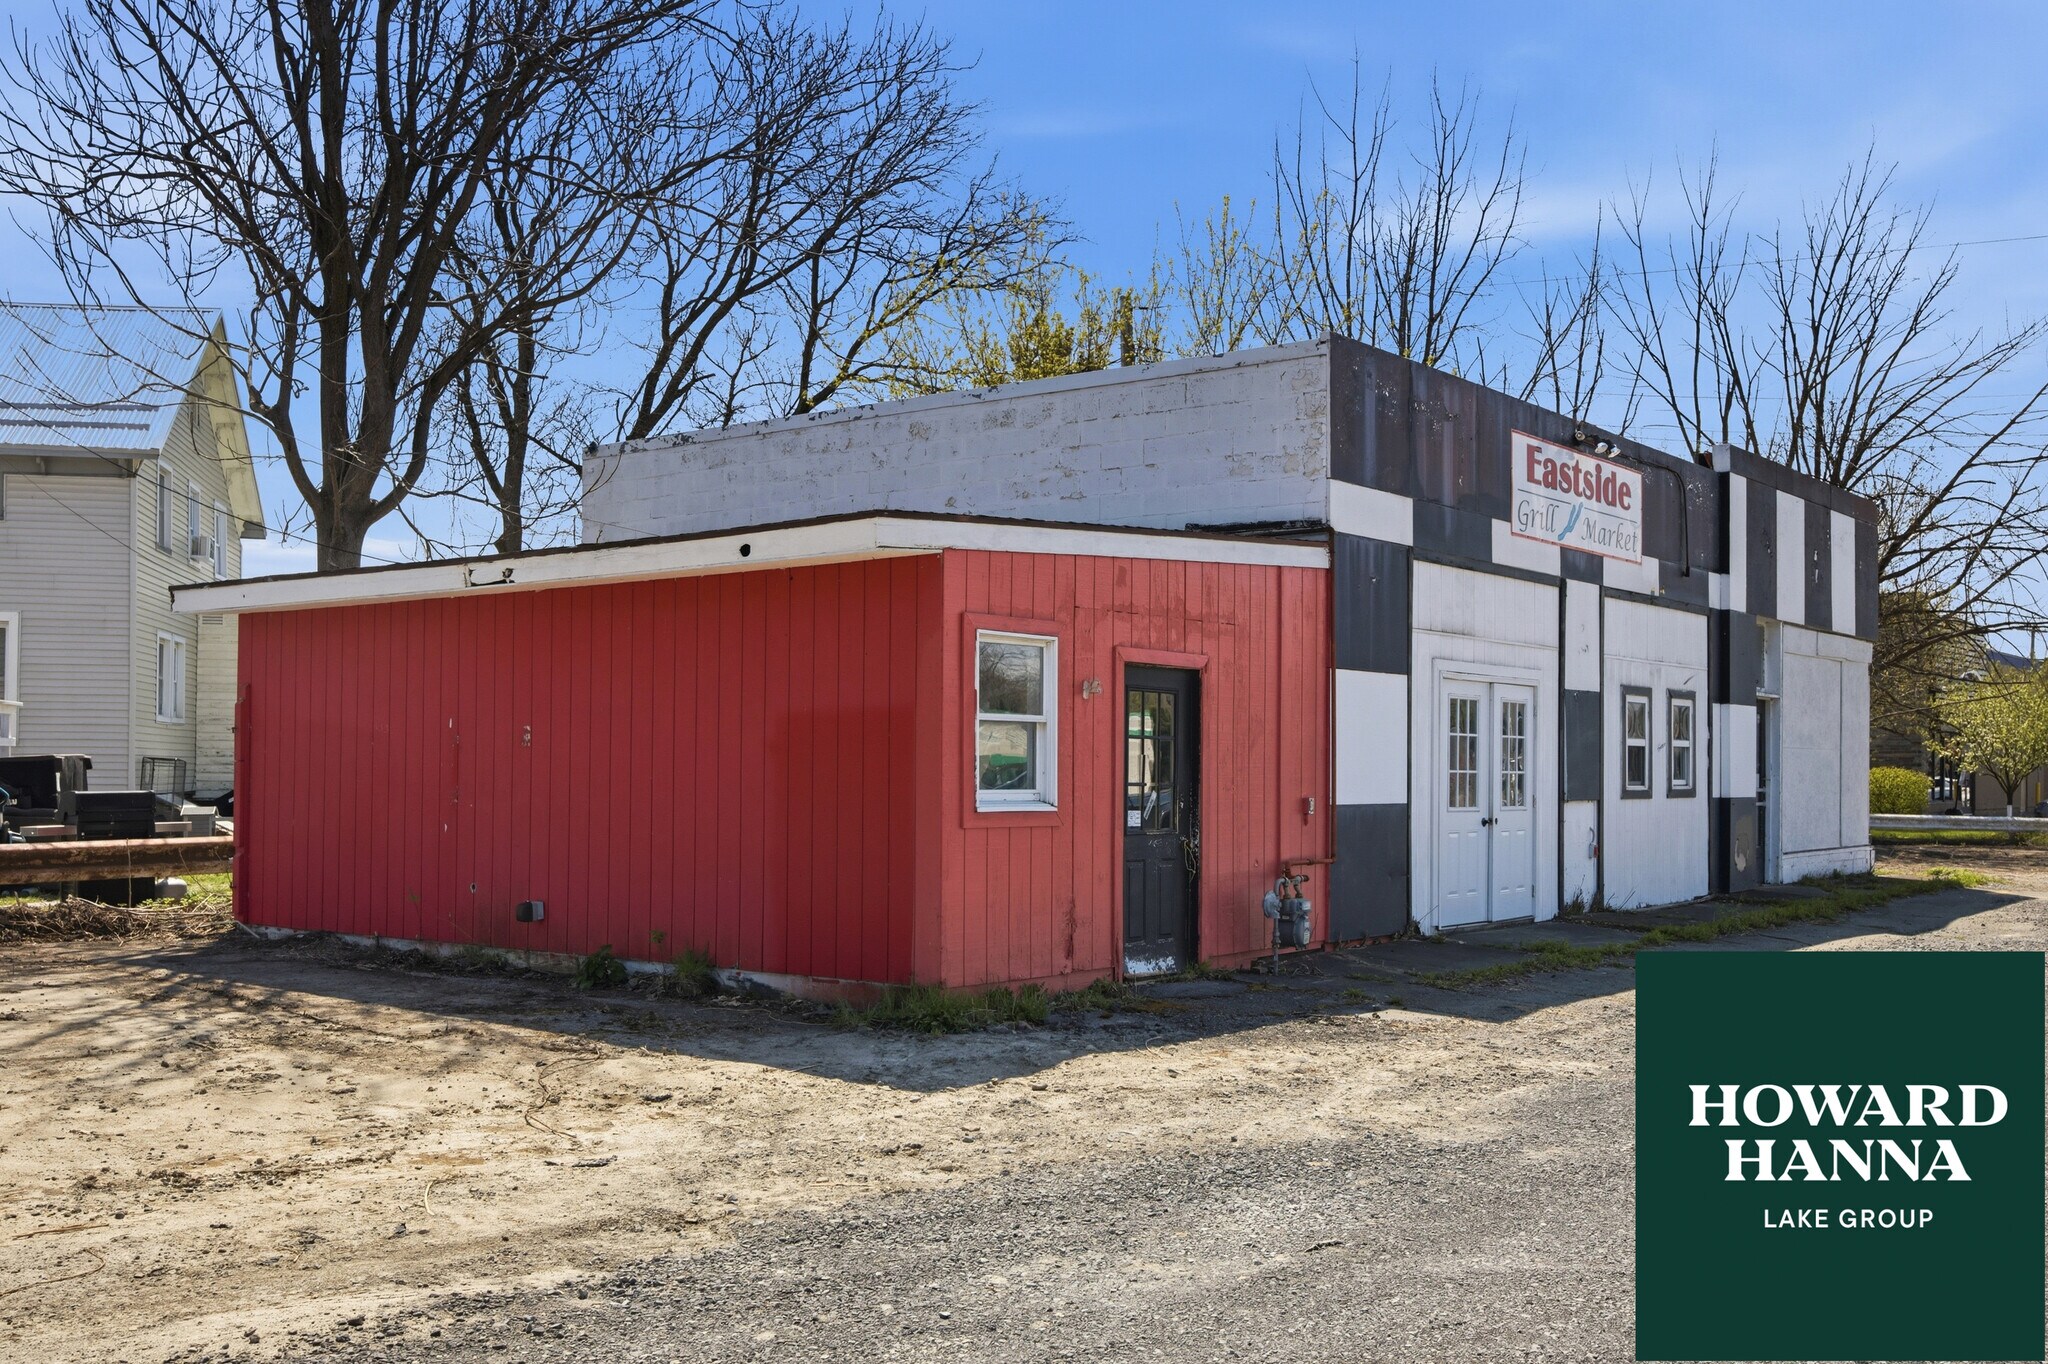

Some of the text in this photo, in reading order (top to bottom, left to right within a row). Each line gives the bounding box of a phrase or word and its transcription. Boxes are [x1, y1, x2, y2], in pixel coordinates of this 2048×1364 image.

[1526, 443, 1632, 511] Eastside
[1518, 499, 1638, 553] Grill Market
